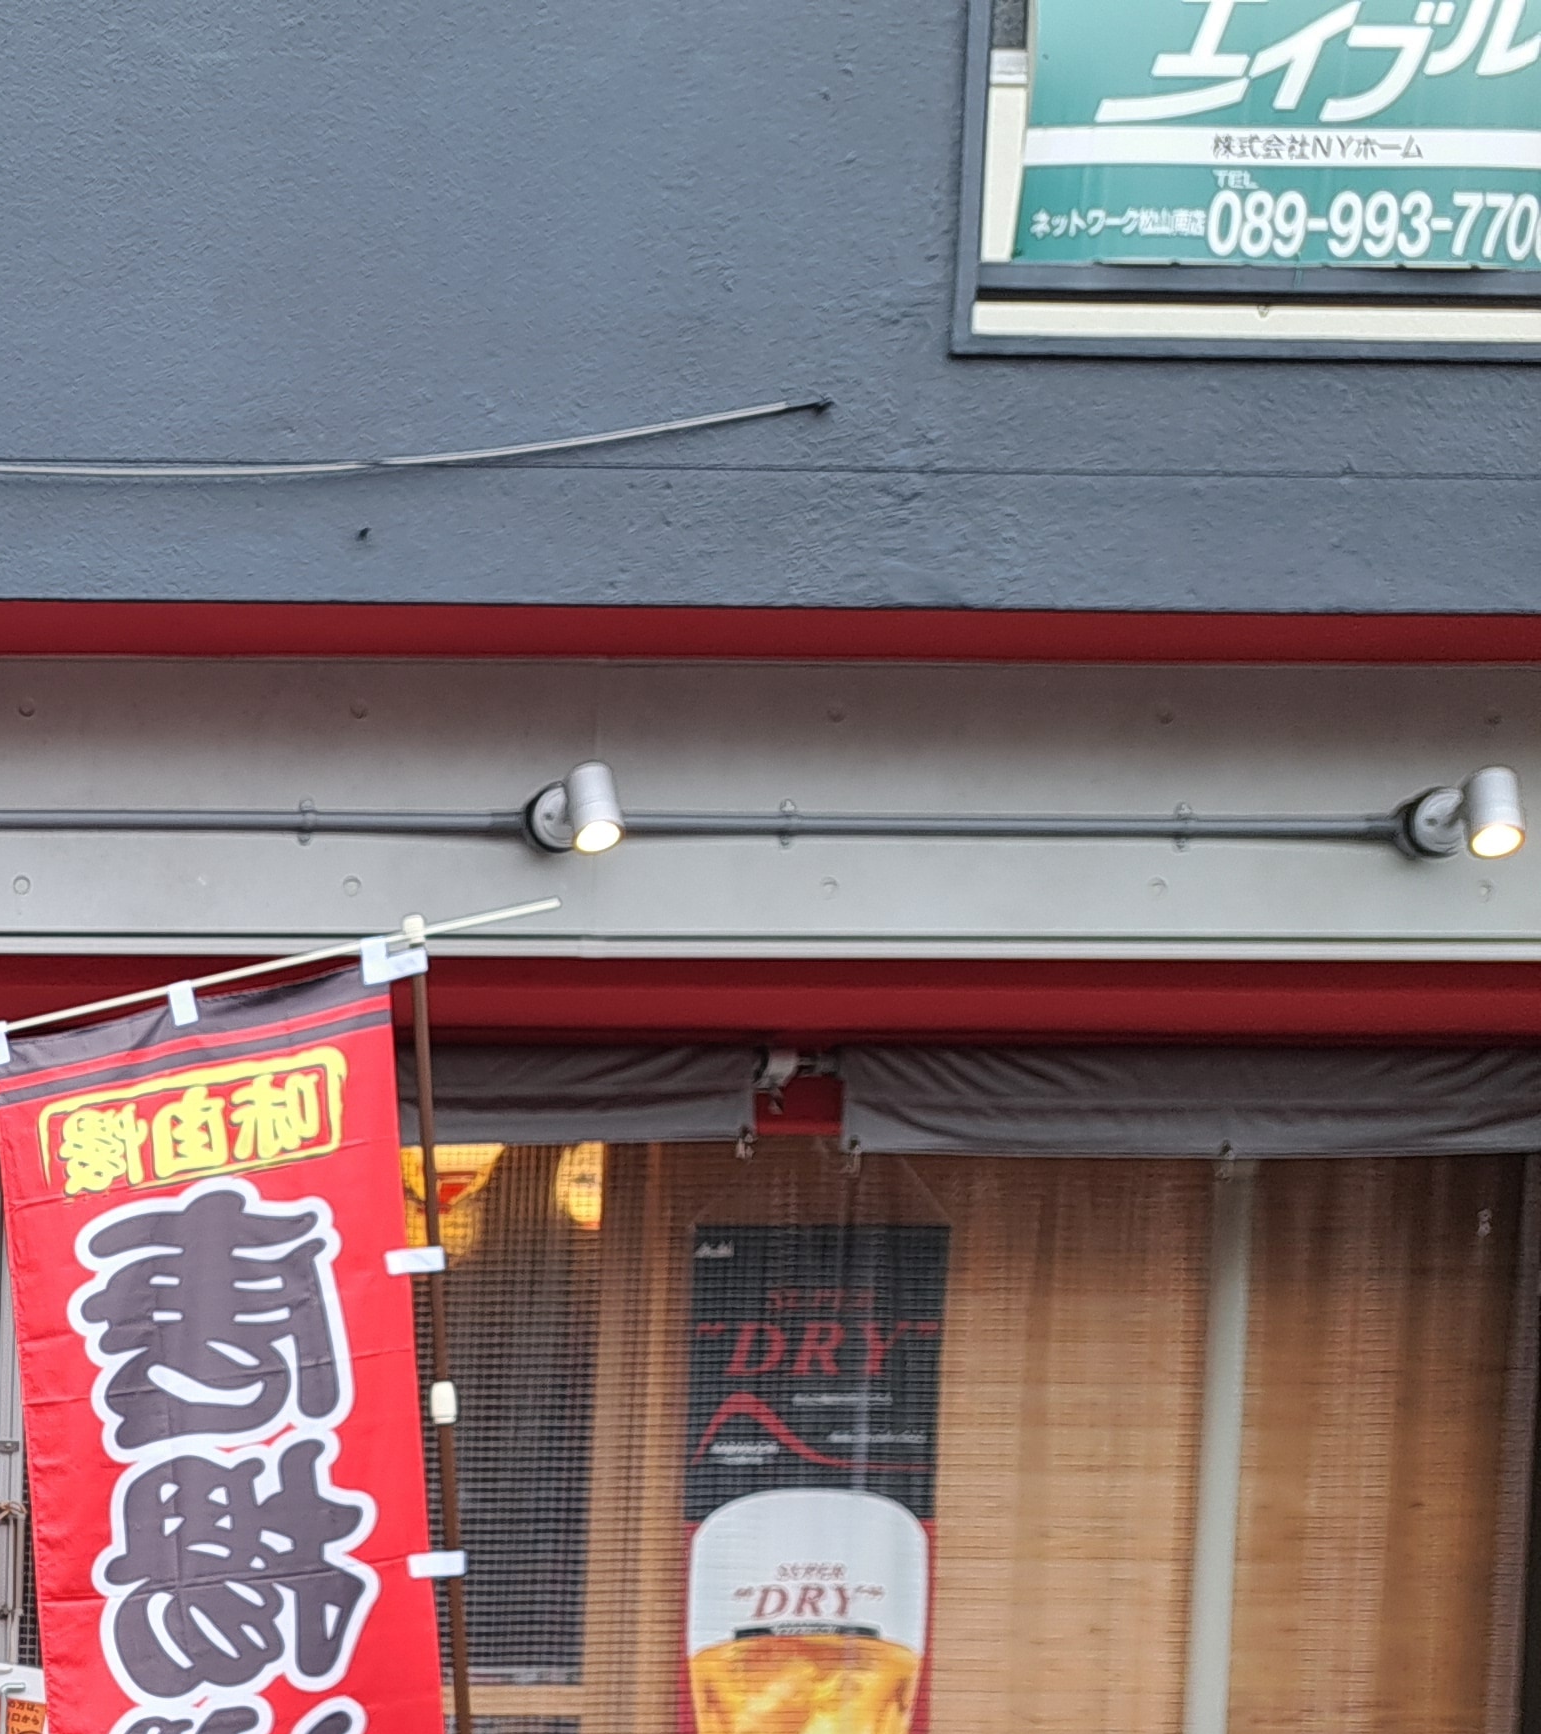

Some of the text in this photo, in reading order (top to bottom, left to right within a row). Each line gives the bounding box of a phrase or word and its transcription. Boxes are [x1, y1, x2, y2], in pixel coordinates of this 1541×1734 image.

[1213, 134, 1424, 160] 株式会社NYホーム
[1213, 169, 1258, 189] TEL
[1208, 189, 1541, 258] 089-993-770
